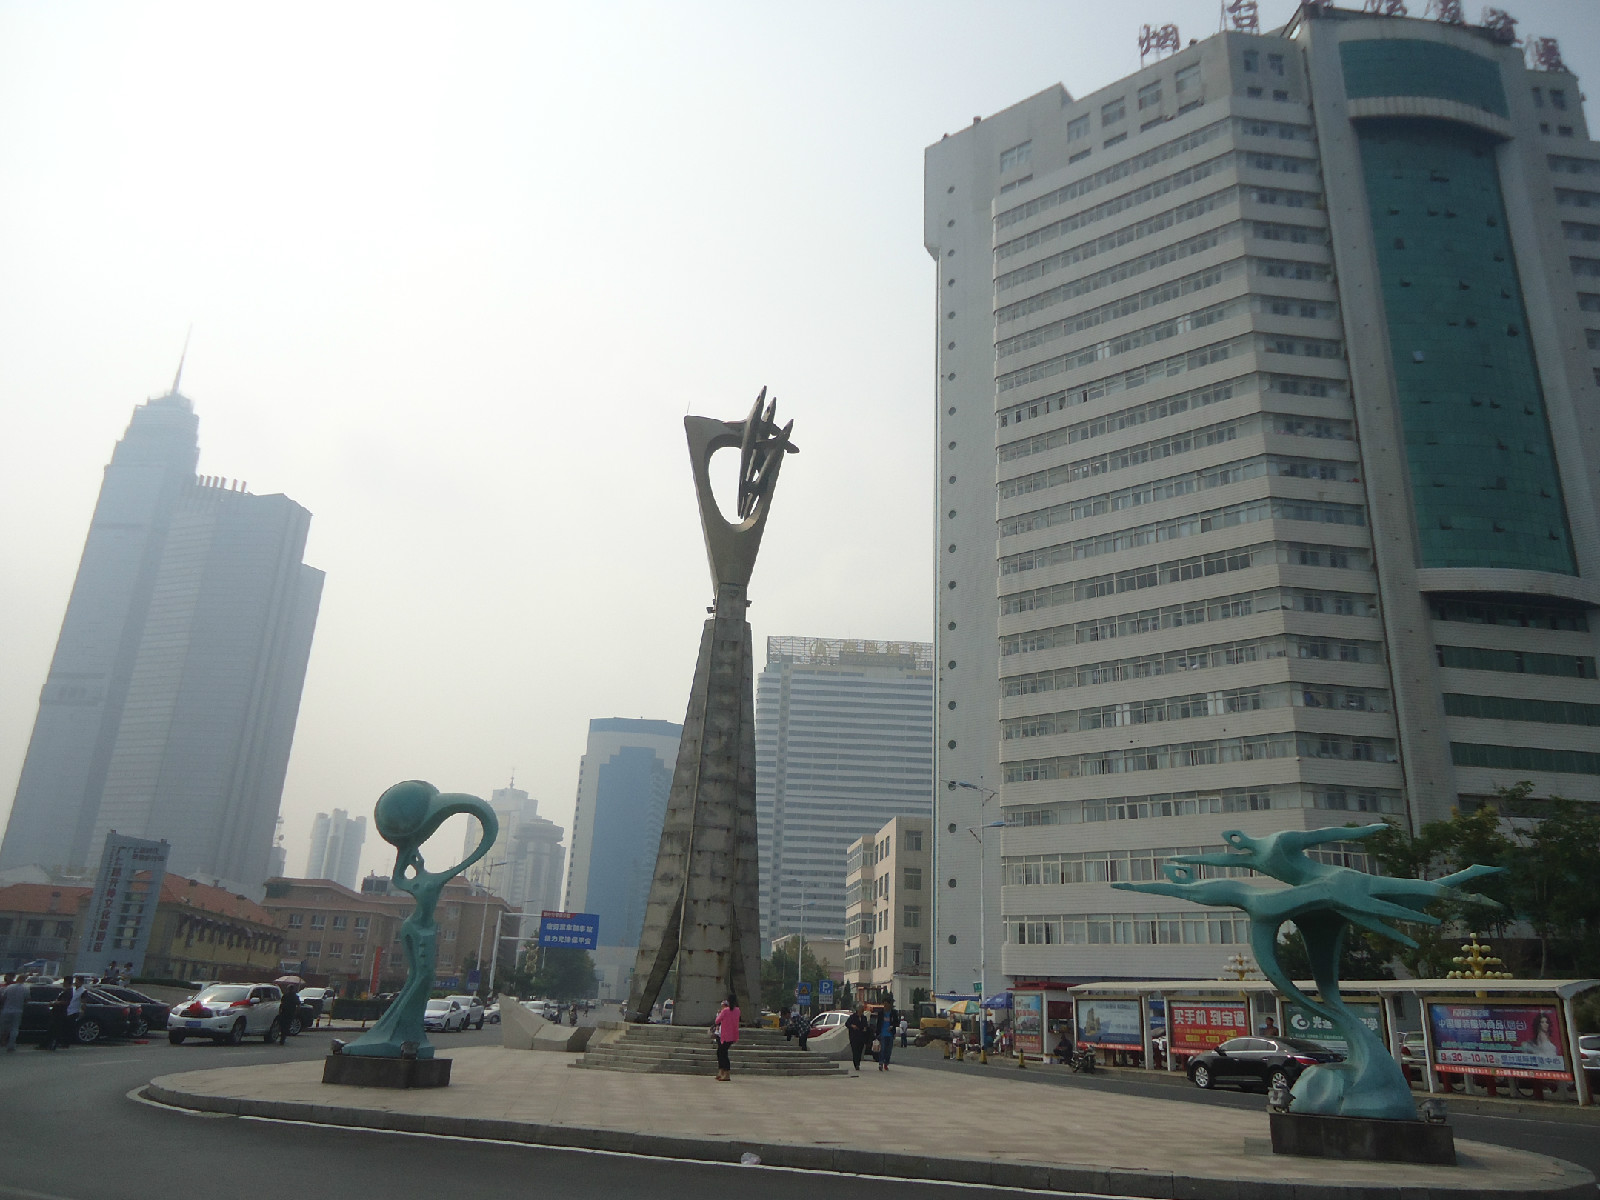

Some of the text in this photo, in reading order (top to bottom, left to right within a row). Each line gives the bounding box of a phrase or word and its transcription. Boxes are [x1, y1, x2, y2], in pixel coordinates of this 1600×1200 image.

[822, 982, 830, 992] P
[1174, 1010, 1245, 1027] 买手机 到宝通
